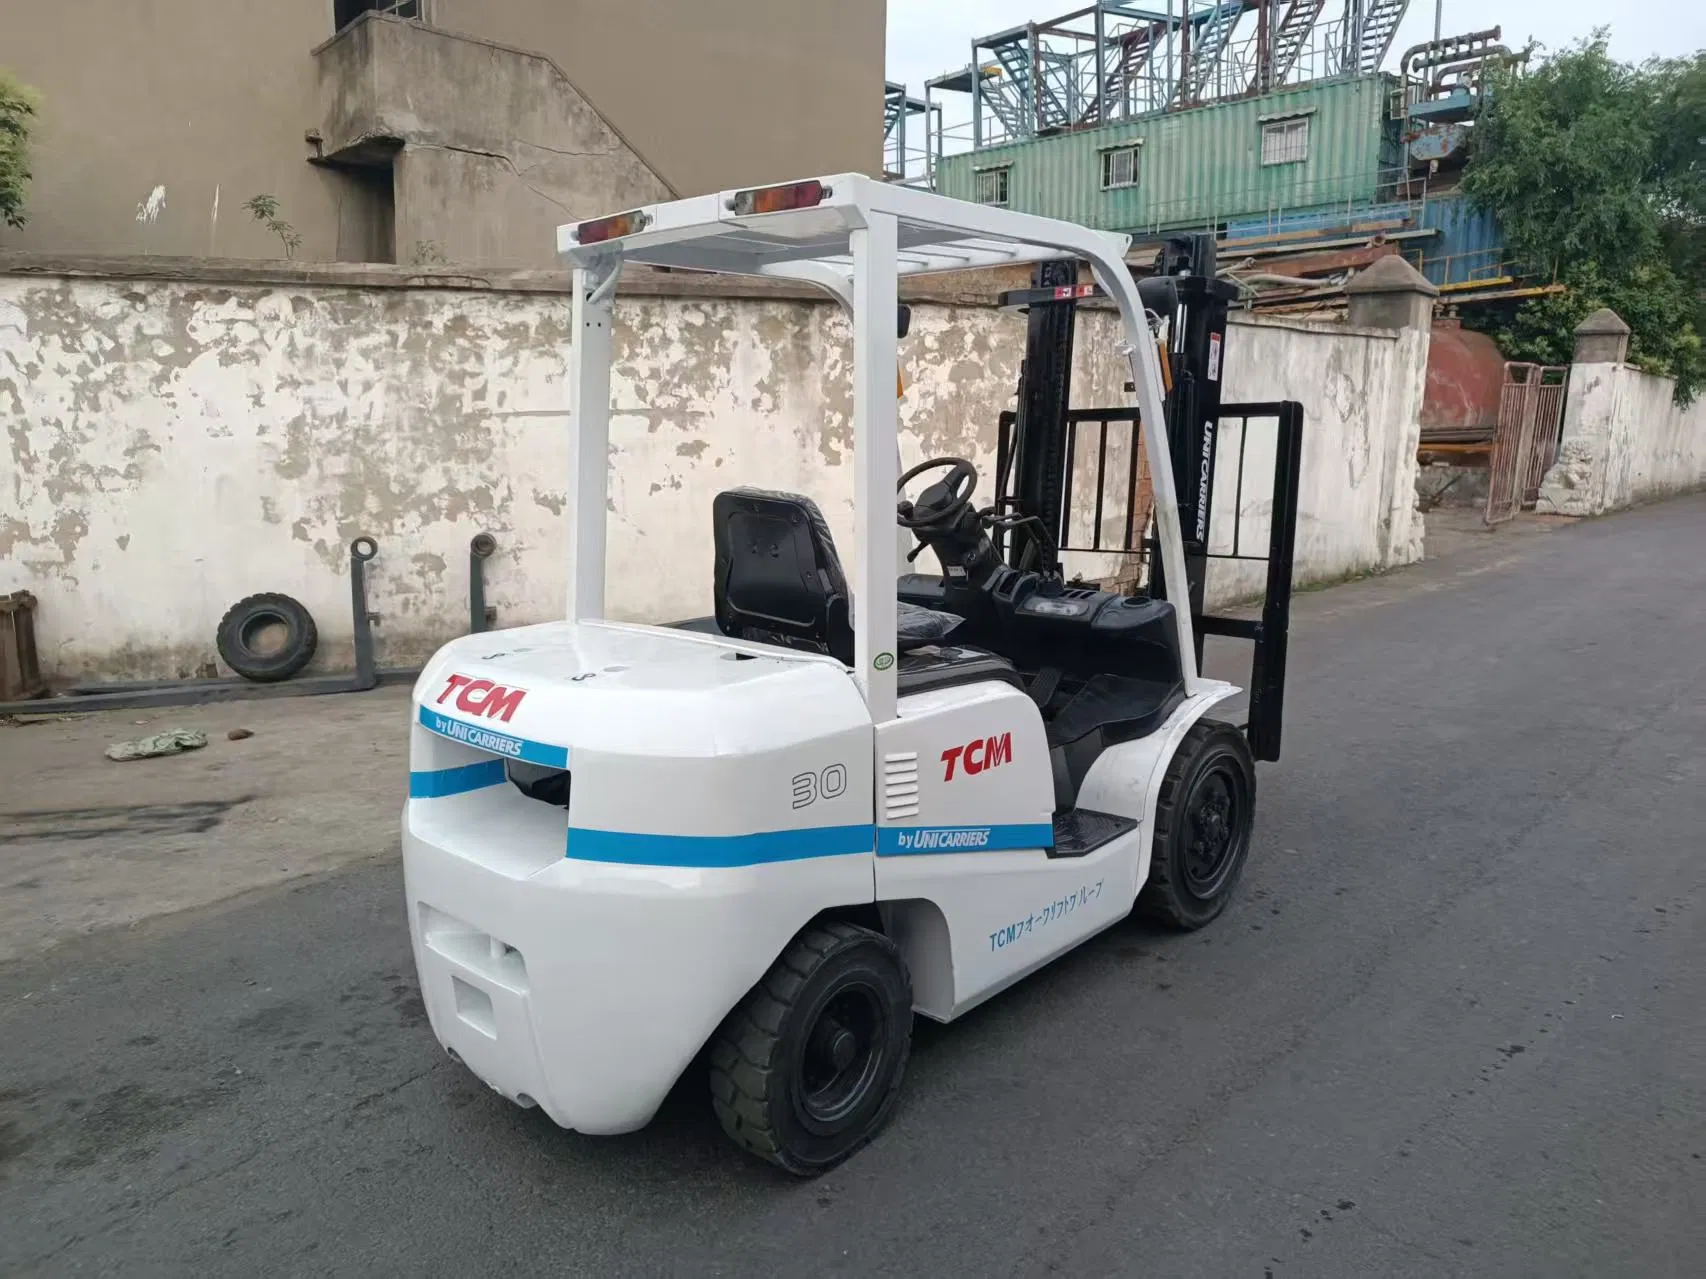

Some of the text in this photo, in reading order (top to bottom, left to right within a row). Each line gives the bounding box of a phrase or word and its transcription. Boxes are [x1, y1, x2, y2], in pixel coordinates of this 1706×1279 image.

[1196, 420, 1213, 543] UNICARRIERS
[437, 674, 527, 723] TCM
[435, 716, 524, 756] by UNICARRIERS
[940, 732, 1012, 782] TCM
[792, 763, 847, 810] 30
[898, 828, 991, 849] by UNICARRIERS
